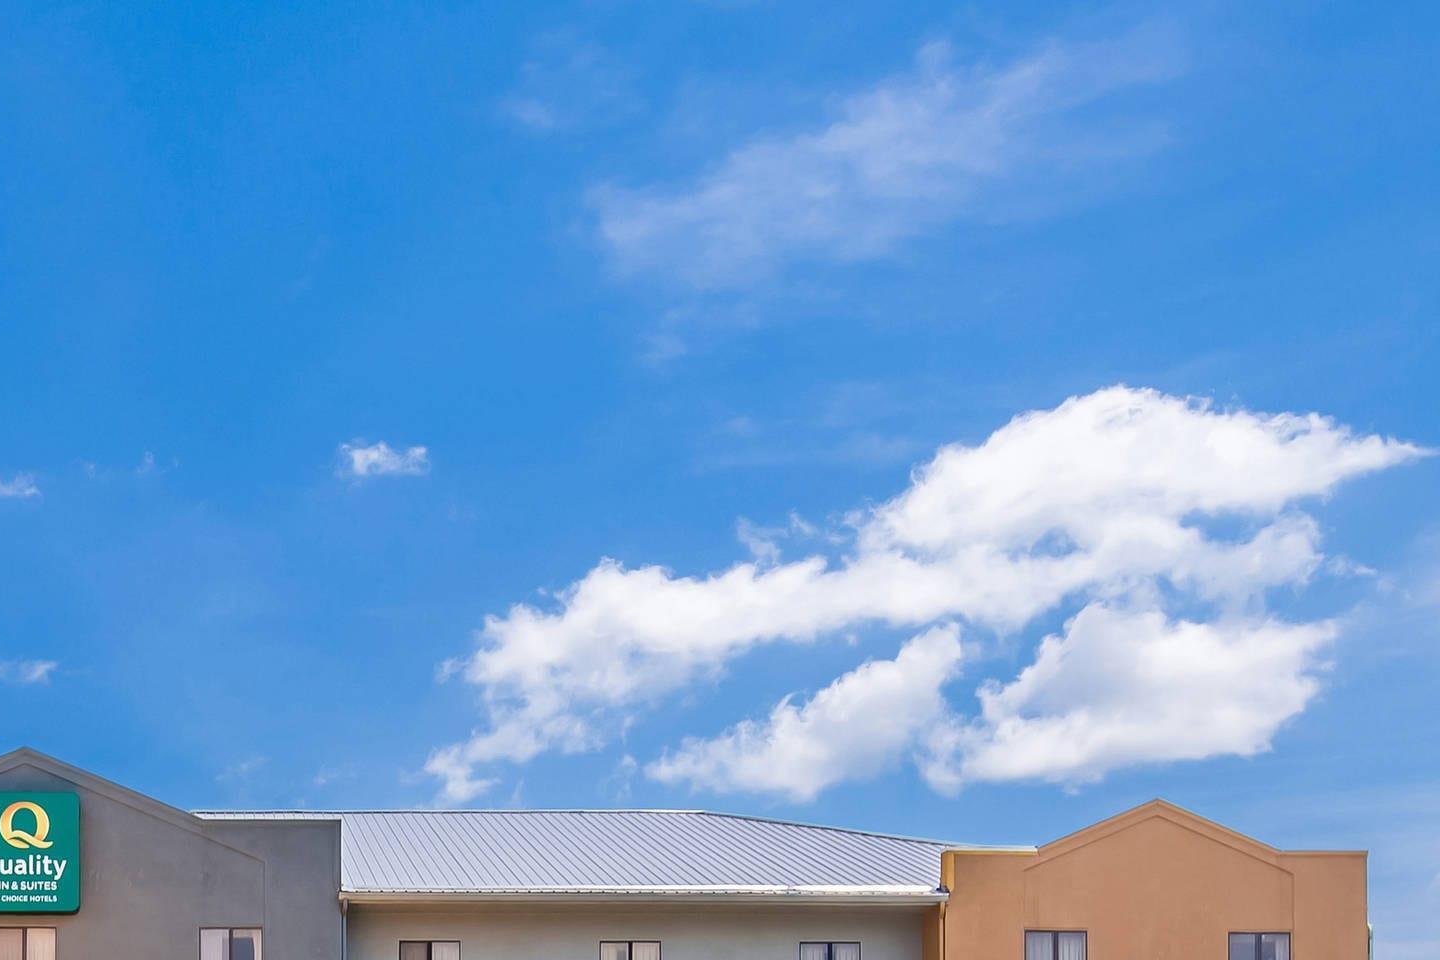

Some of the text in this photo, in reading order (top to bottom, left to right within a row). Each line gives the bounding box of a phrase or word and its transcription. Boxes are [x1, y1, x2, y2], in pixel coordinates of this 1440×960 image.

[0, 801, 54, 849] Q
[11, 881, 18, 890] &
[20, 881, 57, 890] SUITES
